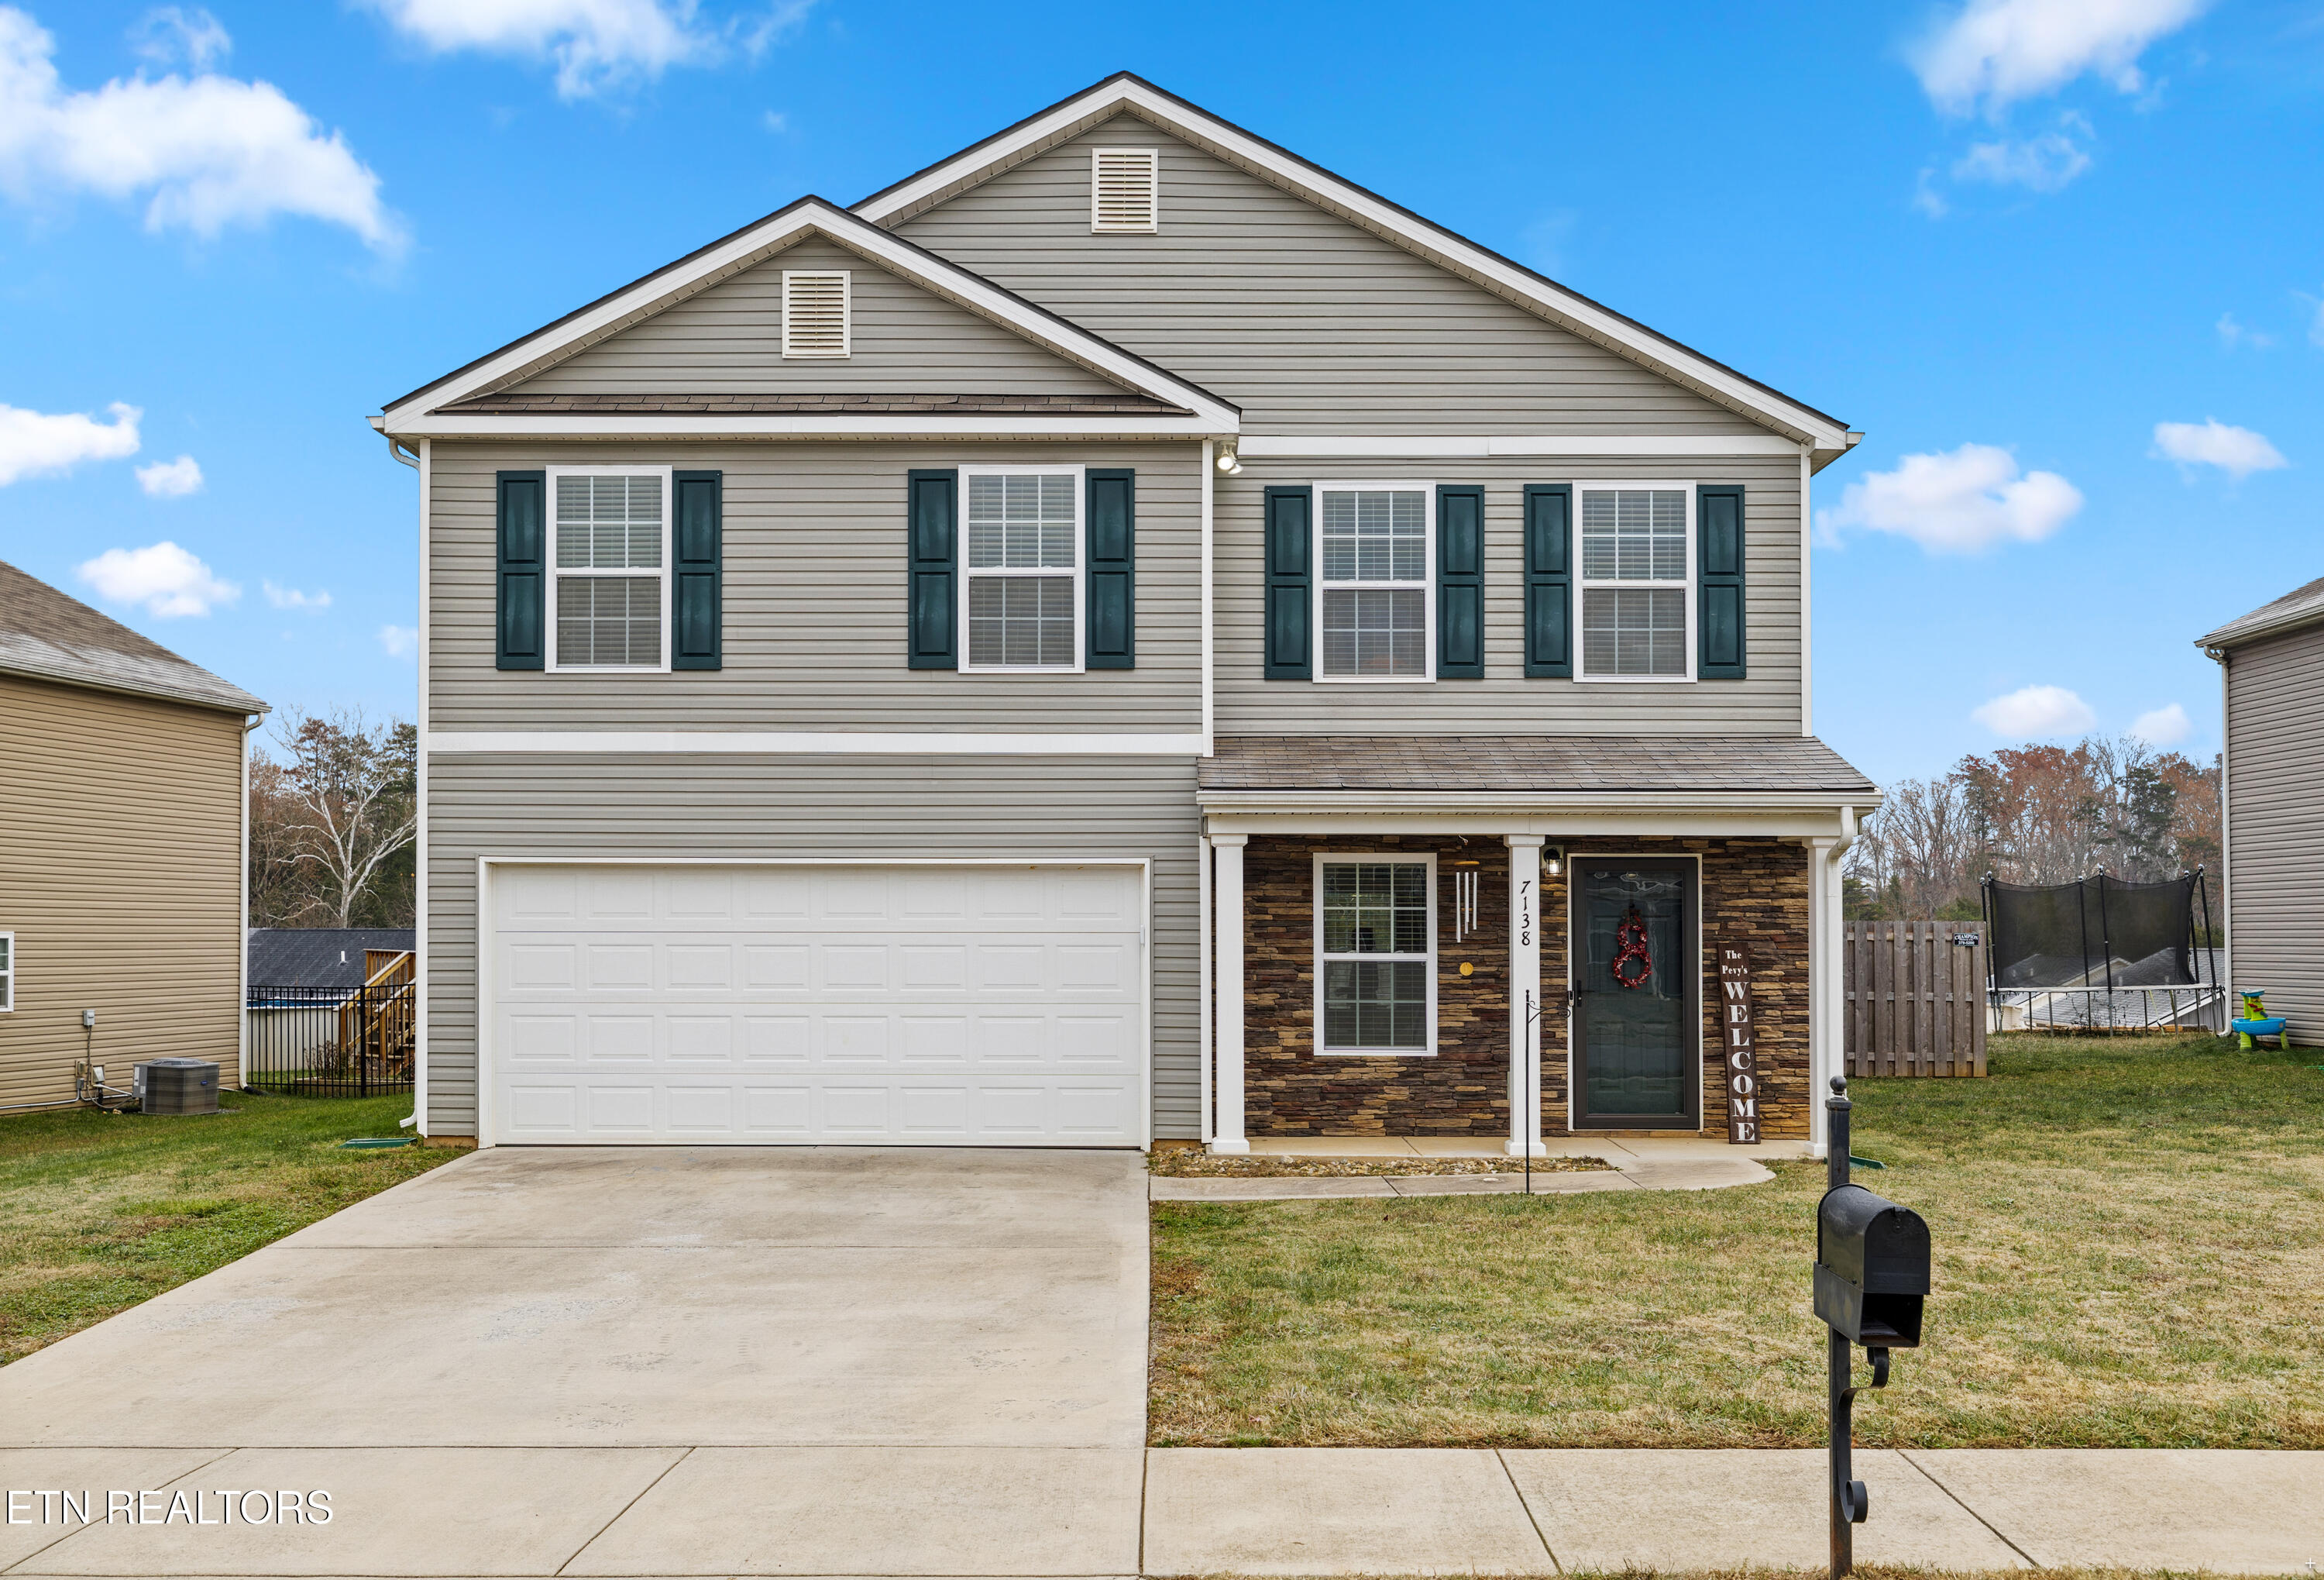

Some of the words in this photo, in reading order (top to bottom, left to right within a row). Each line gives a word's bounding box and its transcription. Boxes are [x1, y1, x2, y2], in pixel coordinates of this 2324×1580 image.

[1521, 880, 1531, 946] 7138
[1725, 950, 1742, 959] The
[1723, 981, 1756, 1141] WELCOME
